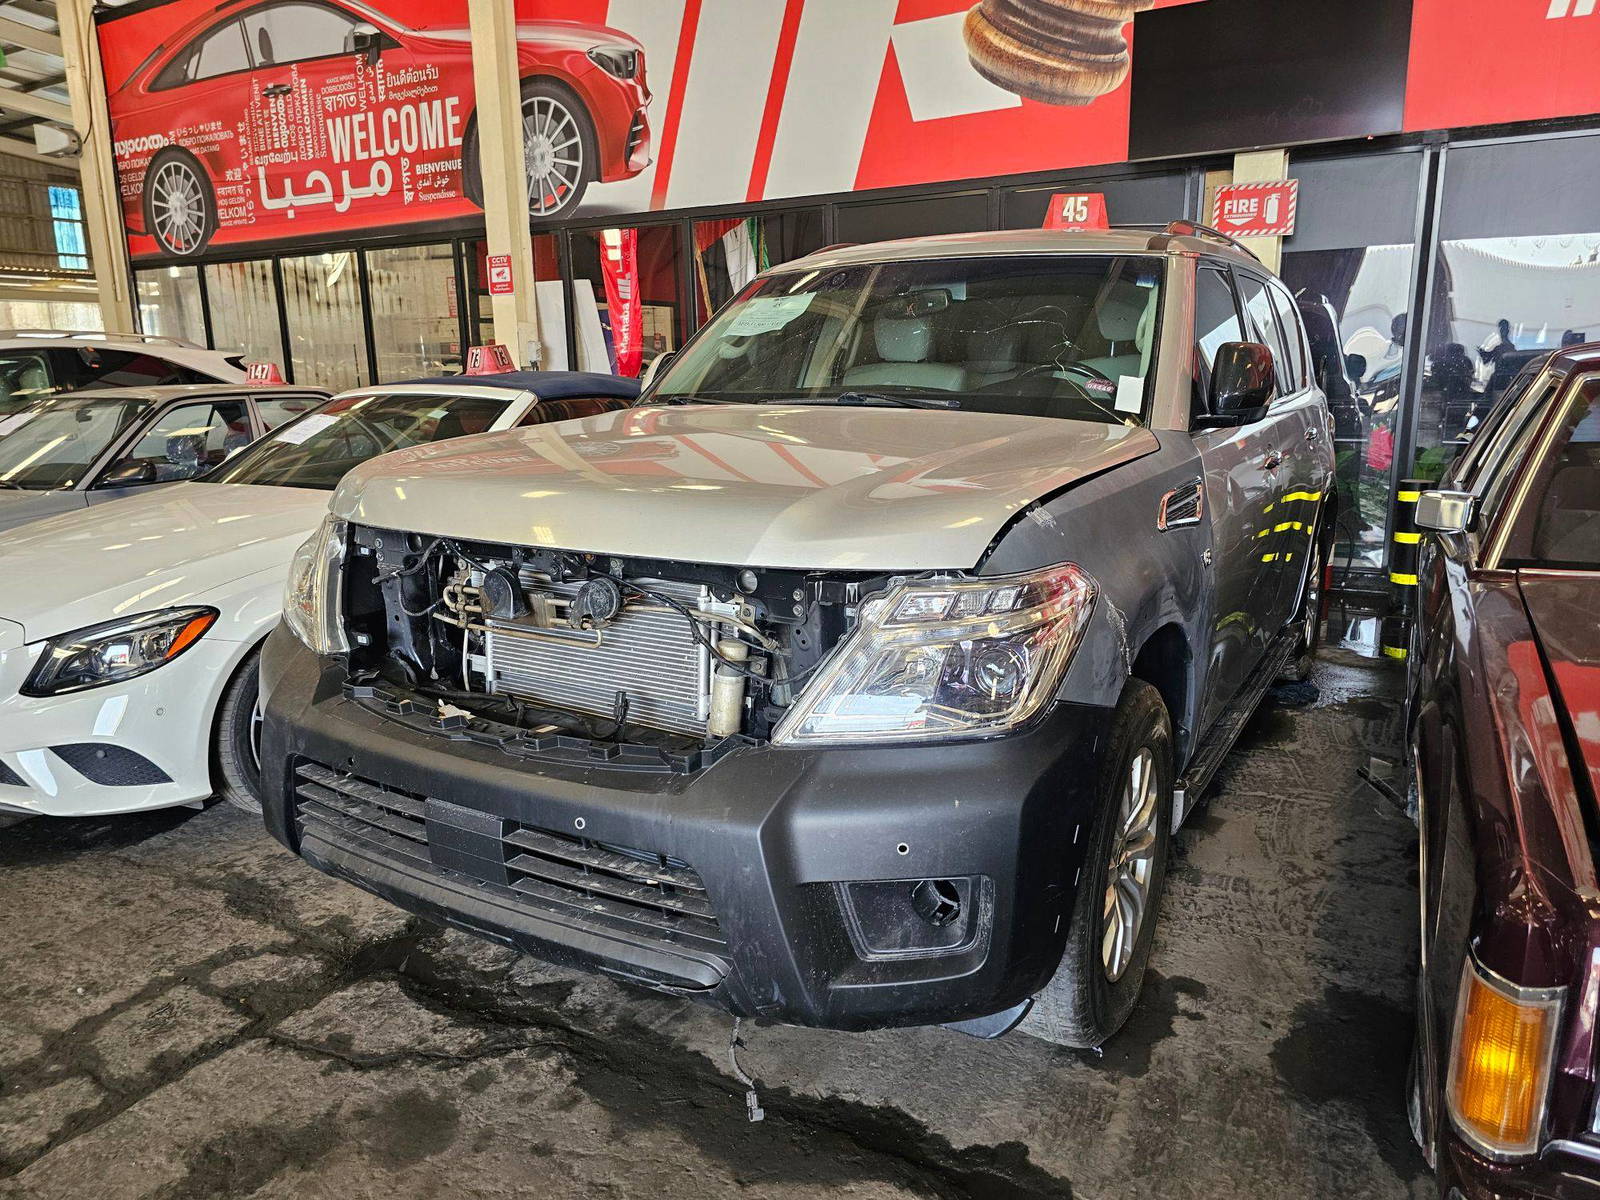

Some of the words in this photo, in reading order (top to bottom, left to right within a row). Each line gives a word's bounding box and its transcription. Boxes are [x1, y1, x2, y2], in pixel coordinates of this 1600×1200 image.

[300, 79, 314, 160] WILLKOMMEN
[326, 96, 463, 164] WELCOME
[415, 159, 462, 175] BIENVENUE
[257, 160, 393, 219] مرحبا
[1062, 196, 1088, 223] 45
[1223, 198, 1259, 214] FIRE
[492, 256, 508, 264] CCTV
[620, 303, 631, 354] Marhaba
[471, 349, 480, 368] 73
[494, 346, 508, 366] 73
[249, 364, 269, 379] 147
